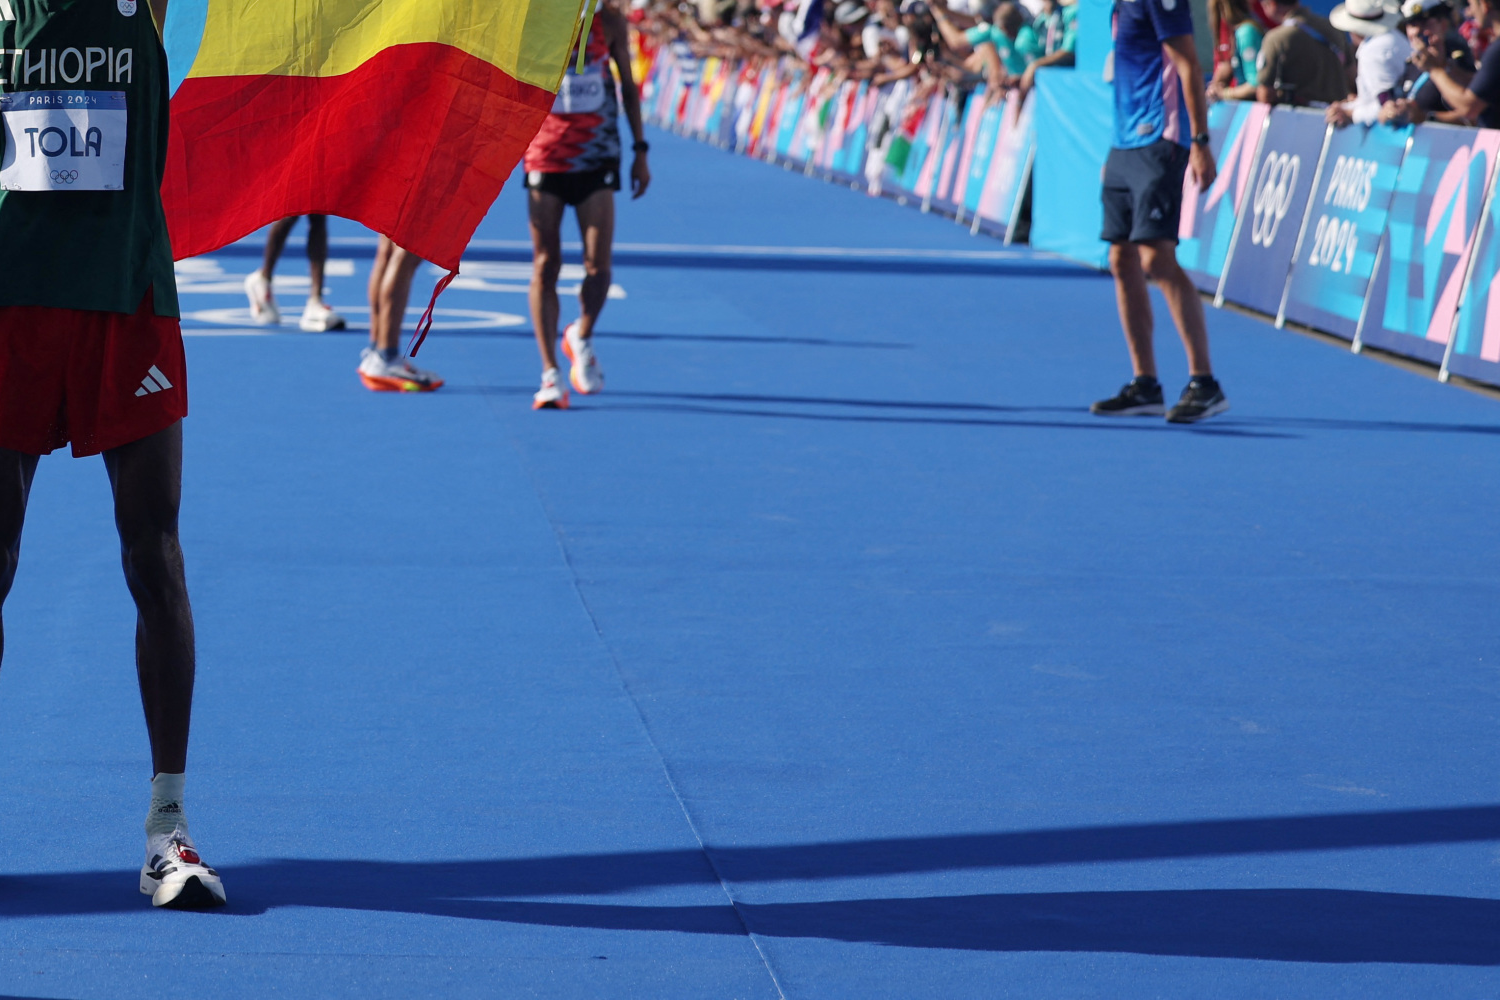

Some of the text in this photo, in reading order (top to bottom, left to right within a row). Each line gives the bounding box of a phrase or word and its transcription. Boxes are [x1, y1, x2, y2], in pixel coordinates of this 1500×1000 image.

[67, 95, 97, 105] 2024
[24, 126, 102, 158] TOLA
[1308, 214, 1359, 275] 2024
